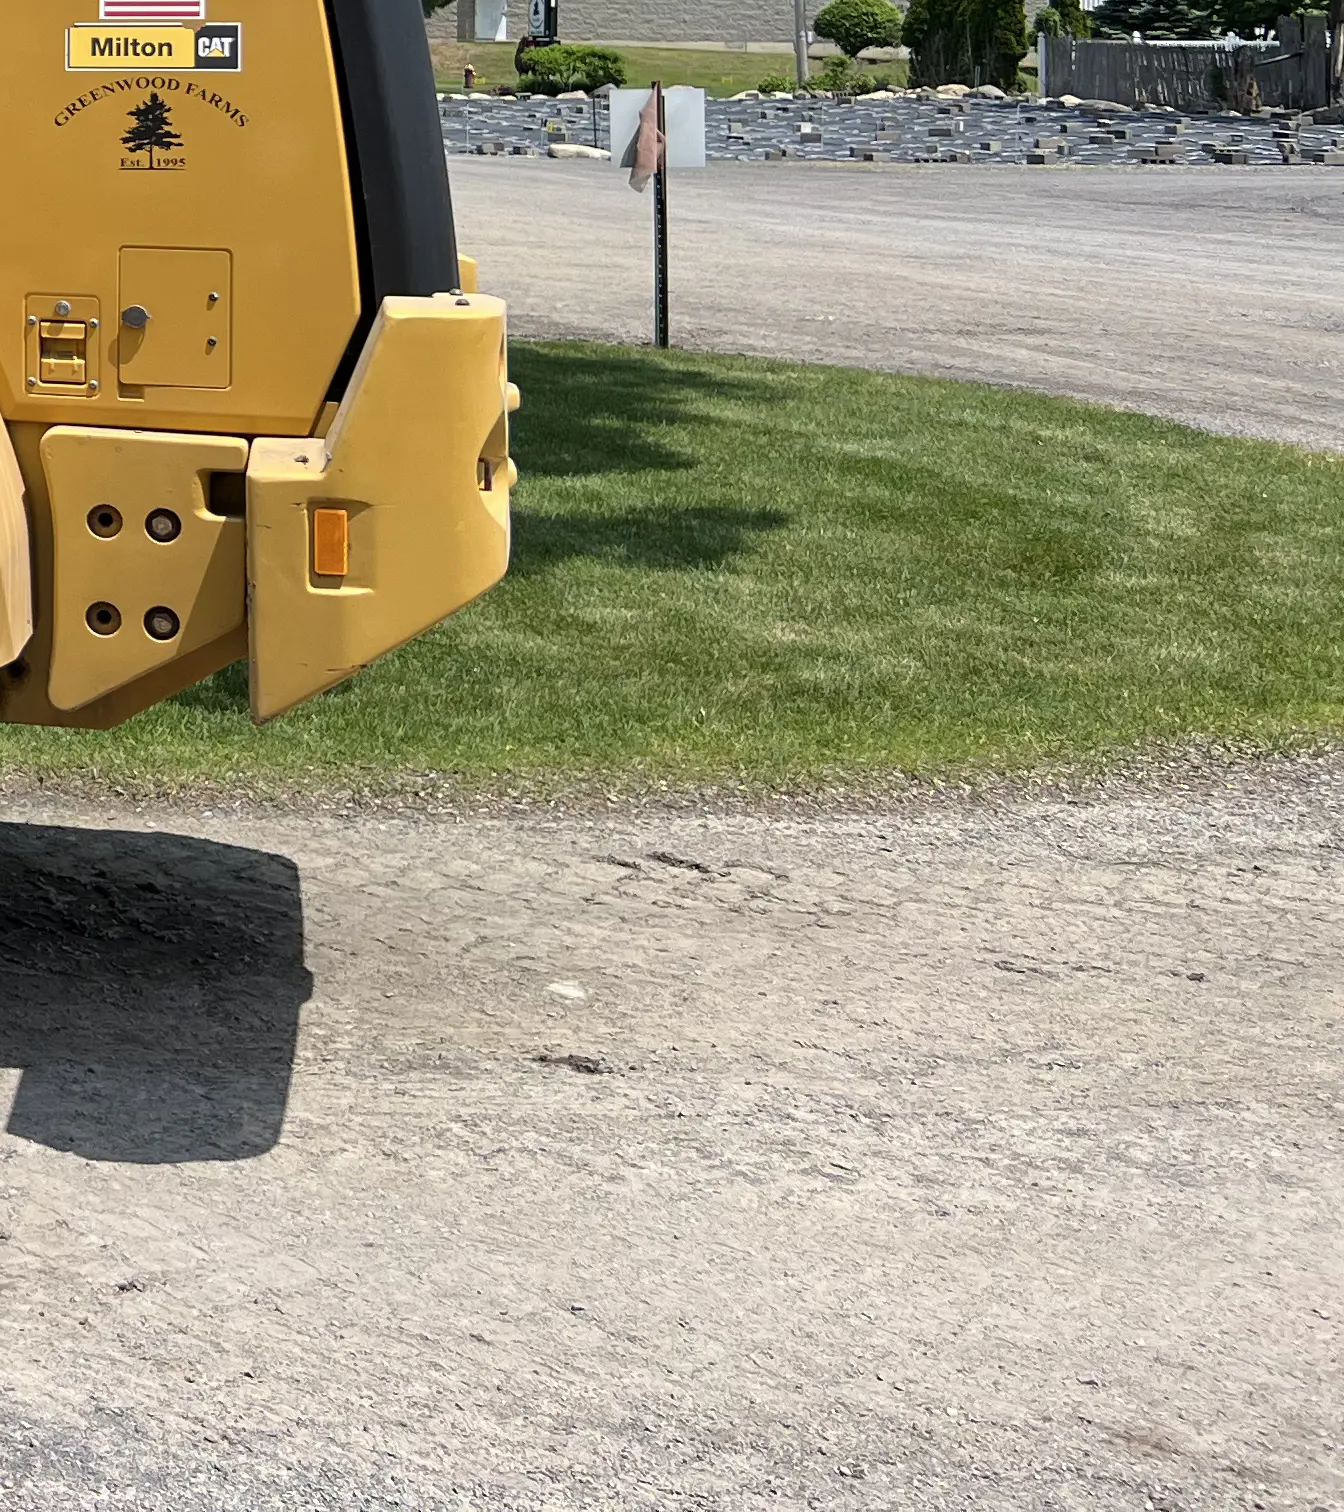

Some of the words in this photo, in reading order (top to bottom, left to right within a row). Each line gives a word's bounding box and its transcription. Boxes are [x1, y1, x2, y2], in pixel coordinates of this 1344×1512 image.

[90, 37, 173, 57] Milton
[197, 37, 236, 58] CAT
[54, 76, 180, 127] GREENWOOD
[185, 82, 250, 128] FARMS
[120, 157, 145, 168] Est.
[156, 157, 186, 168] 1995
